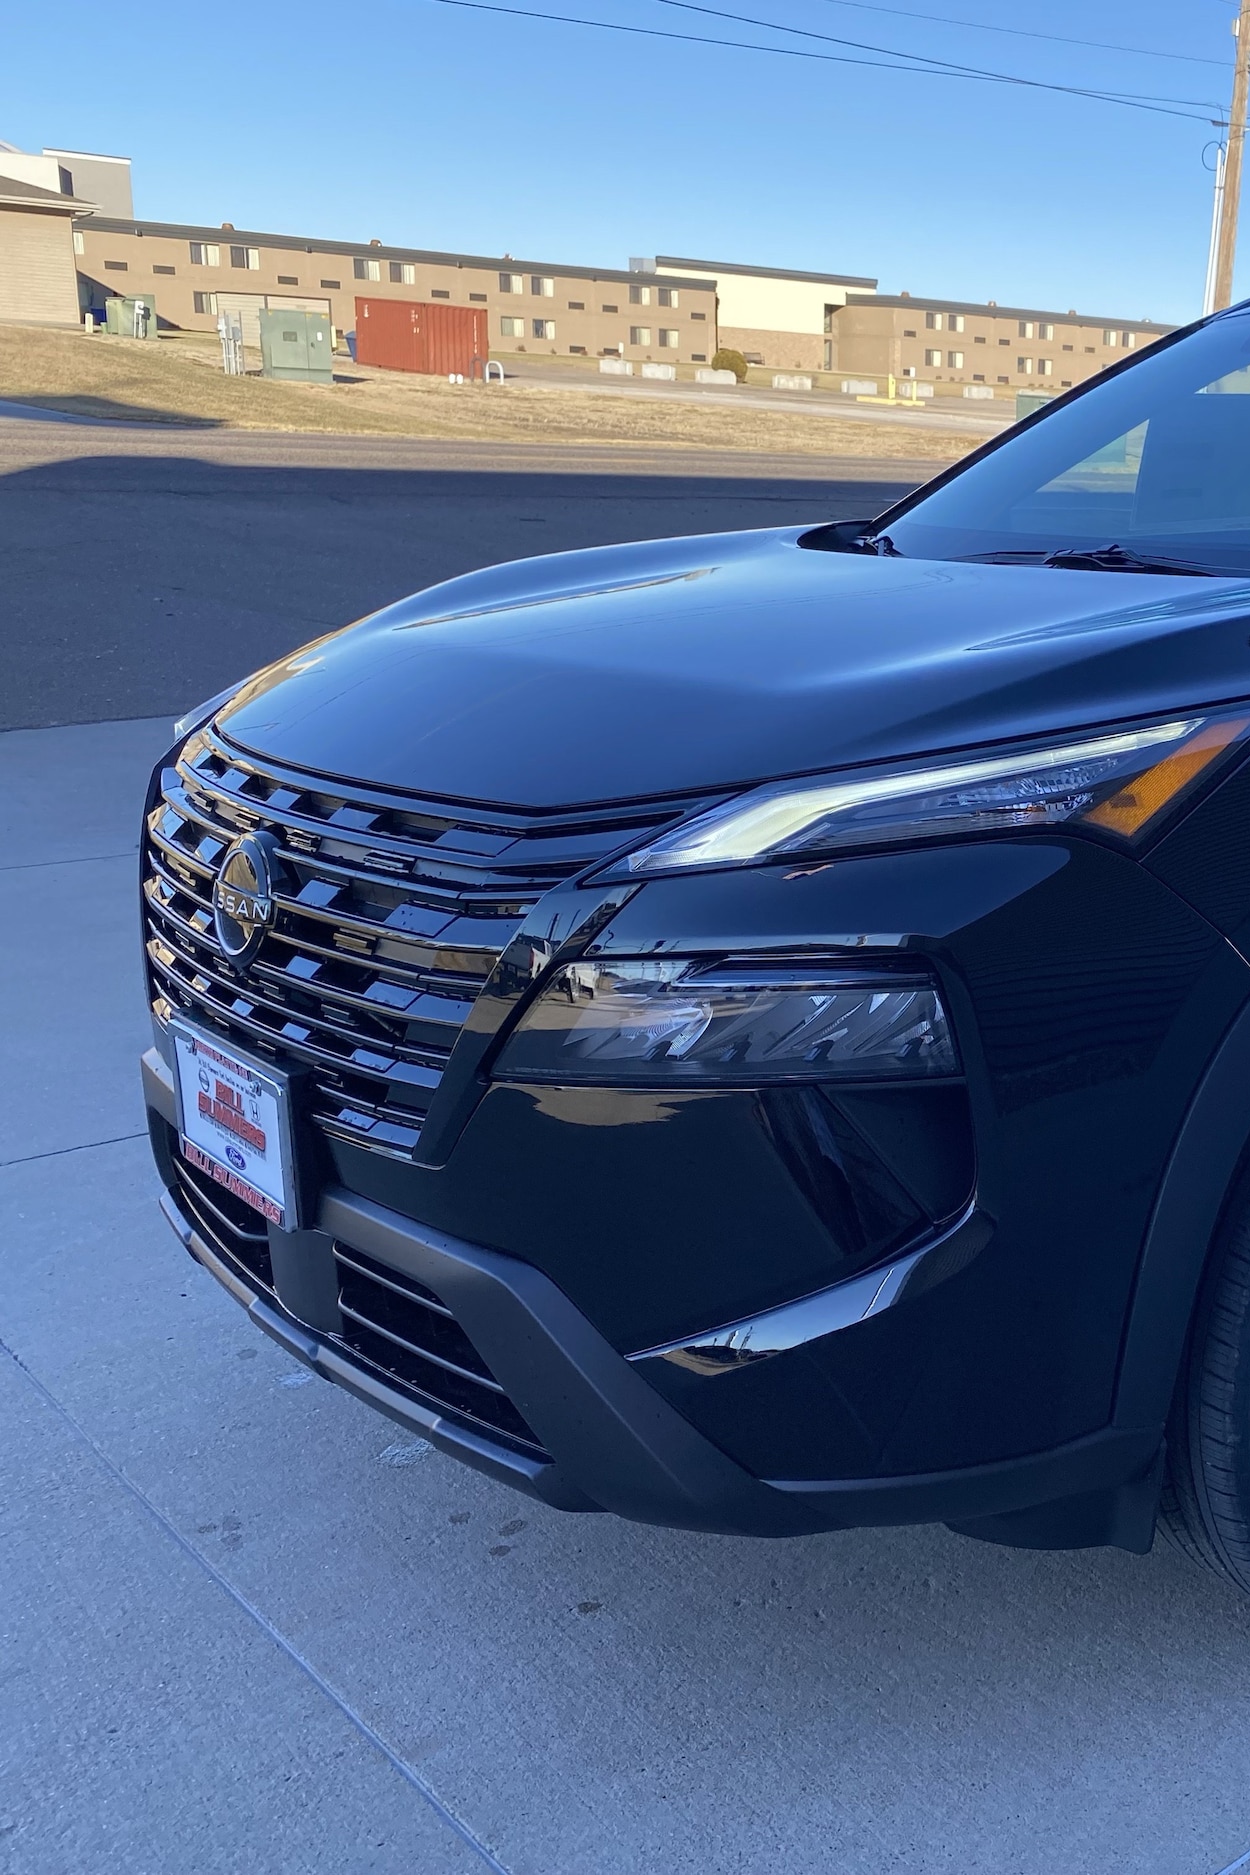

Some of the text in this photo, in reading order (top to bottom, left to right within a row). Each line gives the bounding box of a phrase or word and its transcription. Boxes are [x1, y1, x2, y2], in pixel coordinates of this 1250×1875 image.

[216, 891, 269, 922] SSAN
[198, 1090, 266, 1152] SUMMERS
[215, 1078, 244, 1116] BILL
[184, 1143, 212, 1178] BILL
[213, 1167, 281, 1225] SUMMERS
